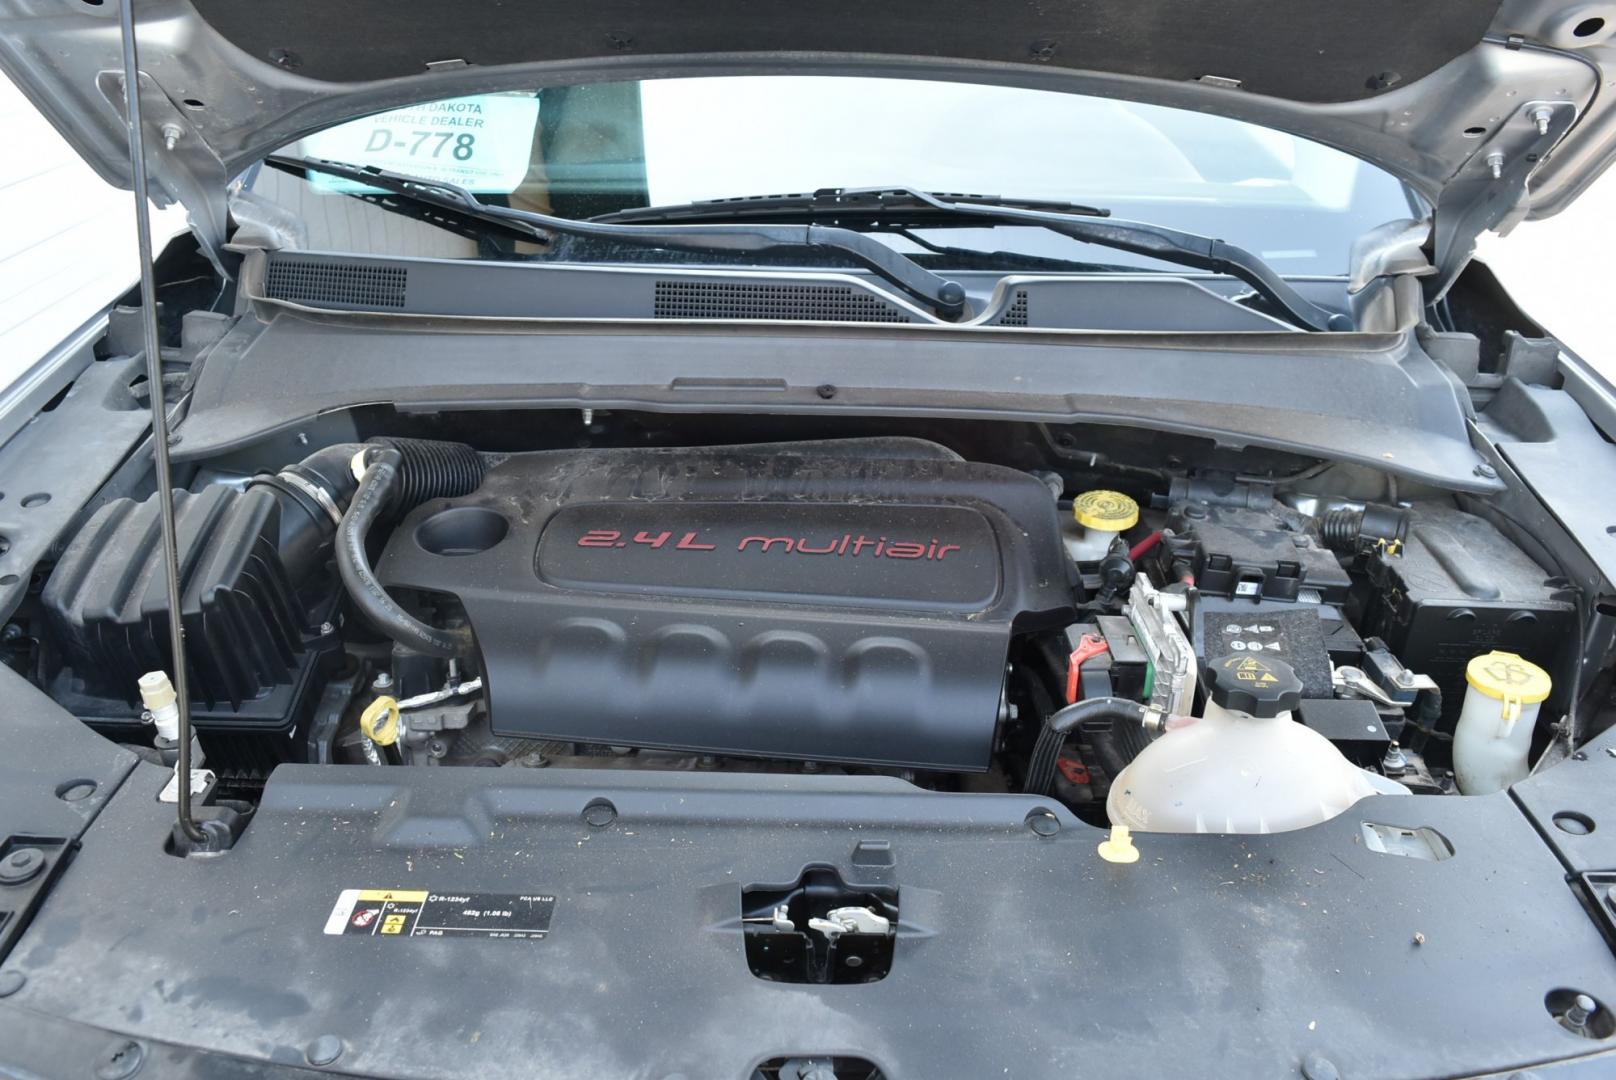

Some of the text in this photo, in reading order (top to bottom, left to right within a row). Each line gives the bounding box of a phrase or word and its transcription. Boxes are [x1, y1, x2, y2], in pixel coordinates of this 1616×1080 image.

[428, 103, 482, 114] DAKOTA
[430, 116, 485, 128] DEALER
[364, 128, 475, 161] D-778
[737, 533, 961, 562] multiair
